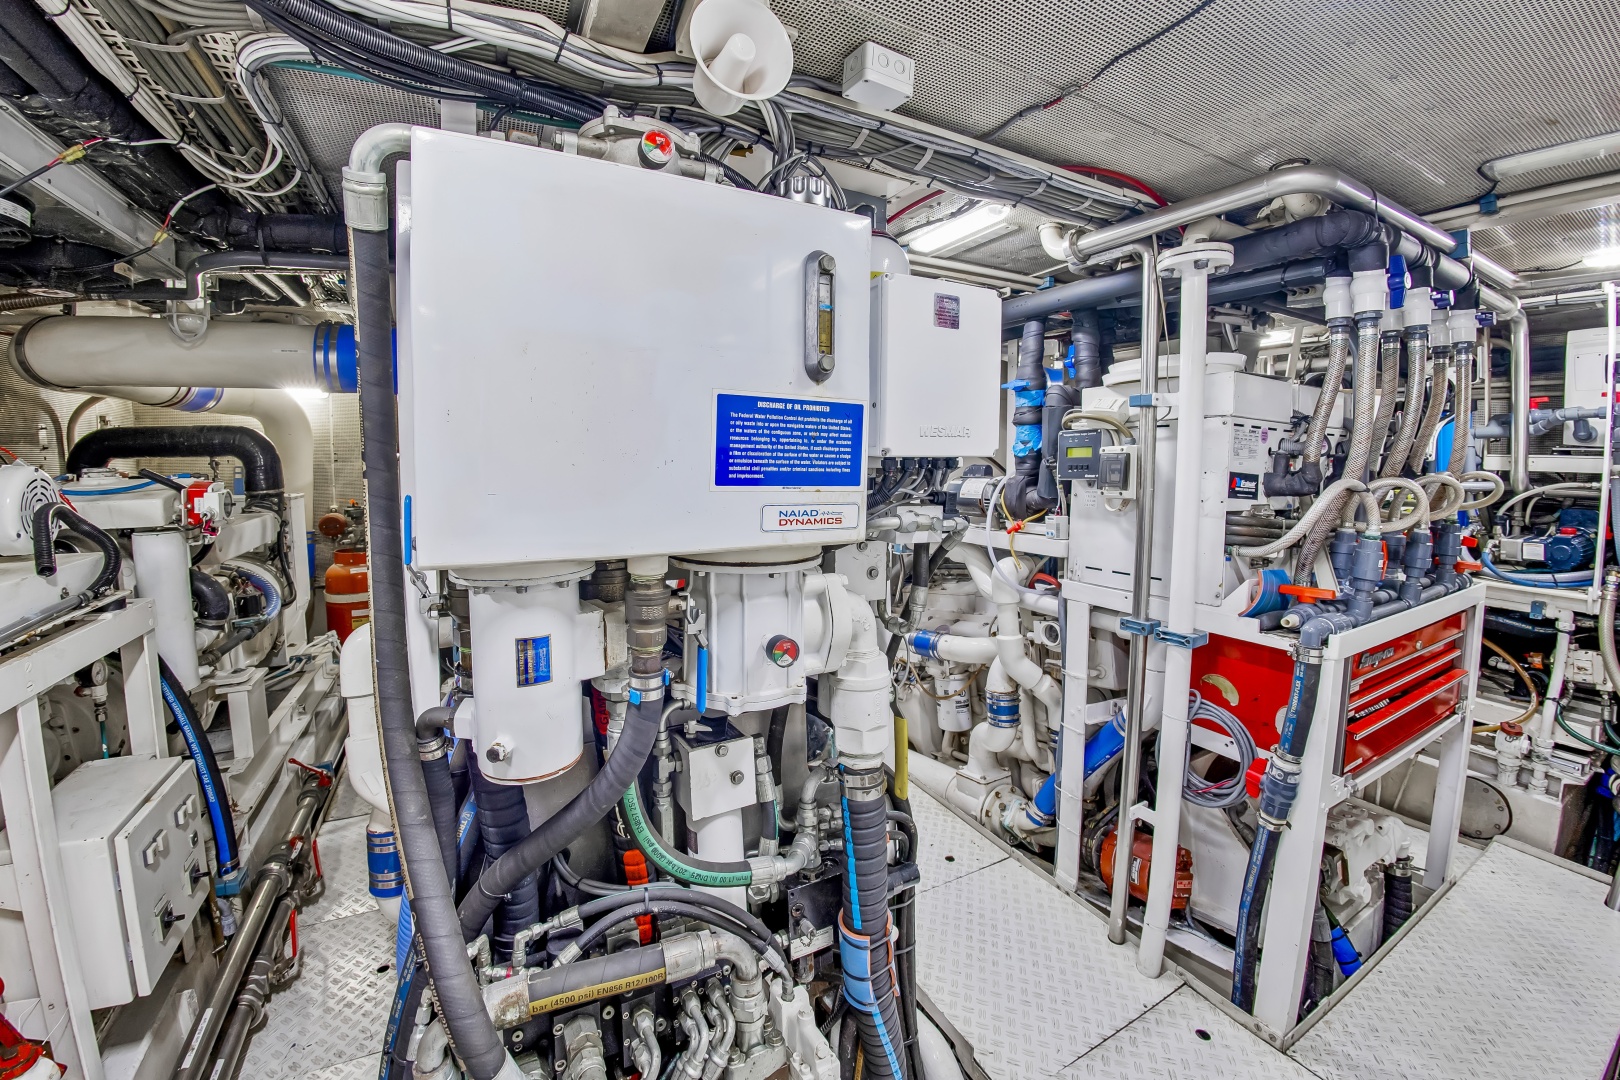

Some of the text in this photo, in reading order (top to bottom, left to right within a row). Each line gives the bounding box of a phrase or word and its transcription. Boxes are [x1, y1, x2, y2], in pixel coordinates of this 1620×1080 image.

[920, 425, 970, 438] WESMAR
[779, 510, 818, 518] NAIAD
[779, 517, 842, 526] DYNAMICS
[1290, 680, 1301, 713] TRIDENT-FLEX
[172, 702, 186, 726] HARDWALL
[183, 725, 194, 743] MARINE
[191, 743, 199, 753] WET
[194, 753, 206, 774] EXHAUST
[632, 812, 644, 833] EN857
[643, 836, 655, 847] psi)
[651, 847, 666, 862] (3000
[665, 860, 676, 871] bar
[676, 865, 687, 875] 207
[691, 872, 708, 881] DN25
[416, 932, 430, 972] Global
[532, 972, 666, 1013] bar (4500 psi) EN856 R12/100R
